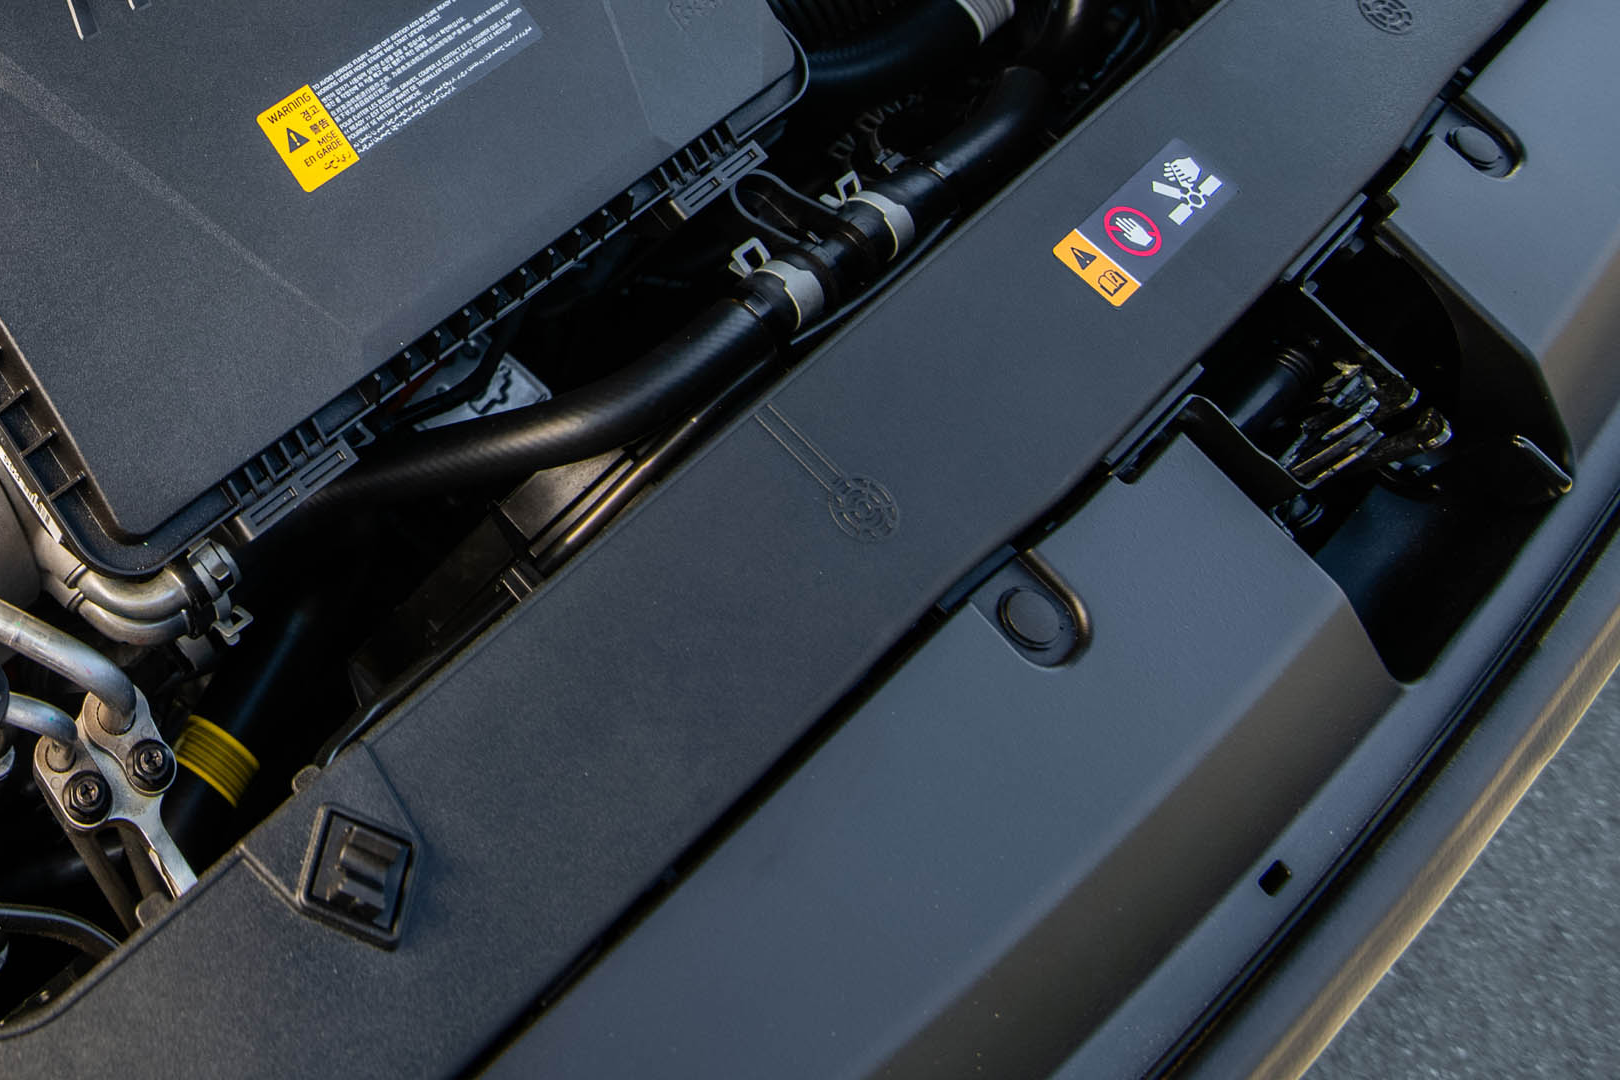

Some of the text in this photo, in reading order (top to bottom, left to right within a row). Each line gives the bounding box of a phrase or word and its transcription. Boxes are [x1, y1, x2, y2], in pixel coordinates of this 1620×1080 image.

[318, 73, 334, 86] AVOID
[332, 61, 353, 77] SERIOUS
[368, 43, 382, 54] TURN
[380, 37, 391, 47] OFF
[408, 19, 419, 29] AND
[424, 8, 437, 18] SURE
[315, 79, 338, 96] WORKING
[336, 69, 354, 82] UNDER
[366, 49, 384, 63] ENGINE
[383, 43, 395, 53] MAY
[393, 34, 408, 46] START
[338, 117, 353, 129] POUR
[368, 101, 378, 110] LES
[417, 62, 437, 78] COUPER
[440, 46, 462, 62] CONTACT
[488, 21, 500, 31] QUE
[348, 117, 365, 131] READY
[369, 108, 380, 118] EST
[394, 88, 410, 101] AVANT
[415, 67, 443, 87] TRAVAILLER
[441, 59, 454, 70] SOUS
[492, 21, 512, 37] MOTEUR
[266, 91, 311, 124] WARNING
[299, 103, 321, 122] 경고
[346, 122, 370, 141] POURRAIT
[375, 106, 396, 122] METTRE
[309, 117, 330, 135] 警告
[316, 129, 338, 147] MISE
[303, 137, 343, 167] EN GARDE
